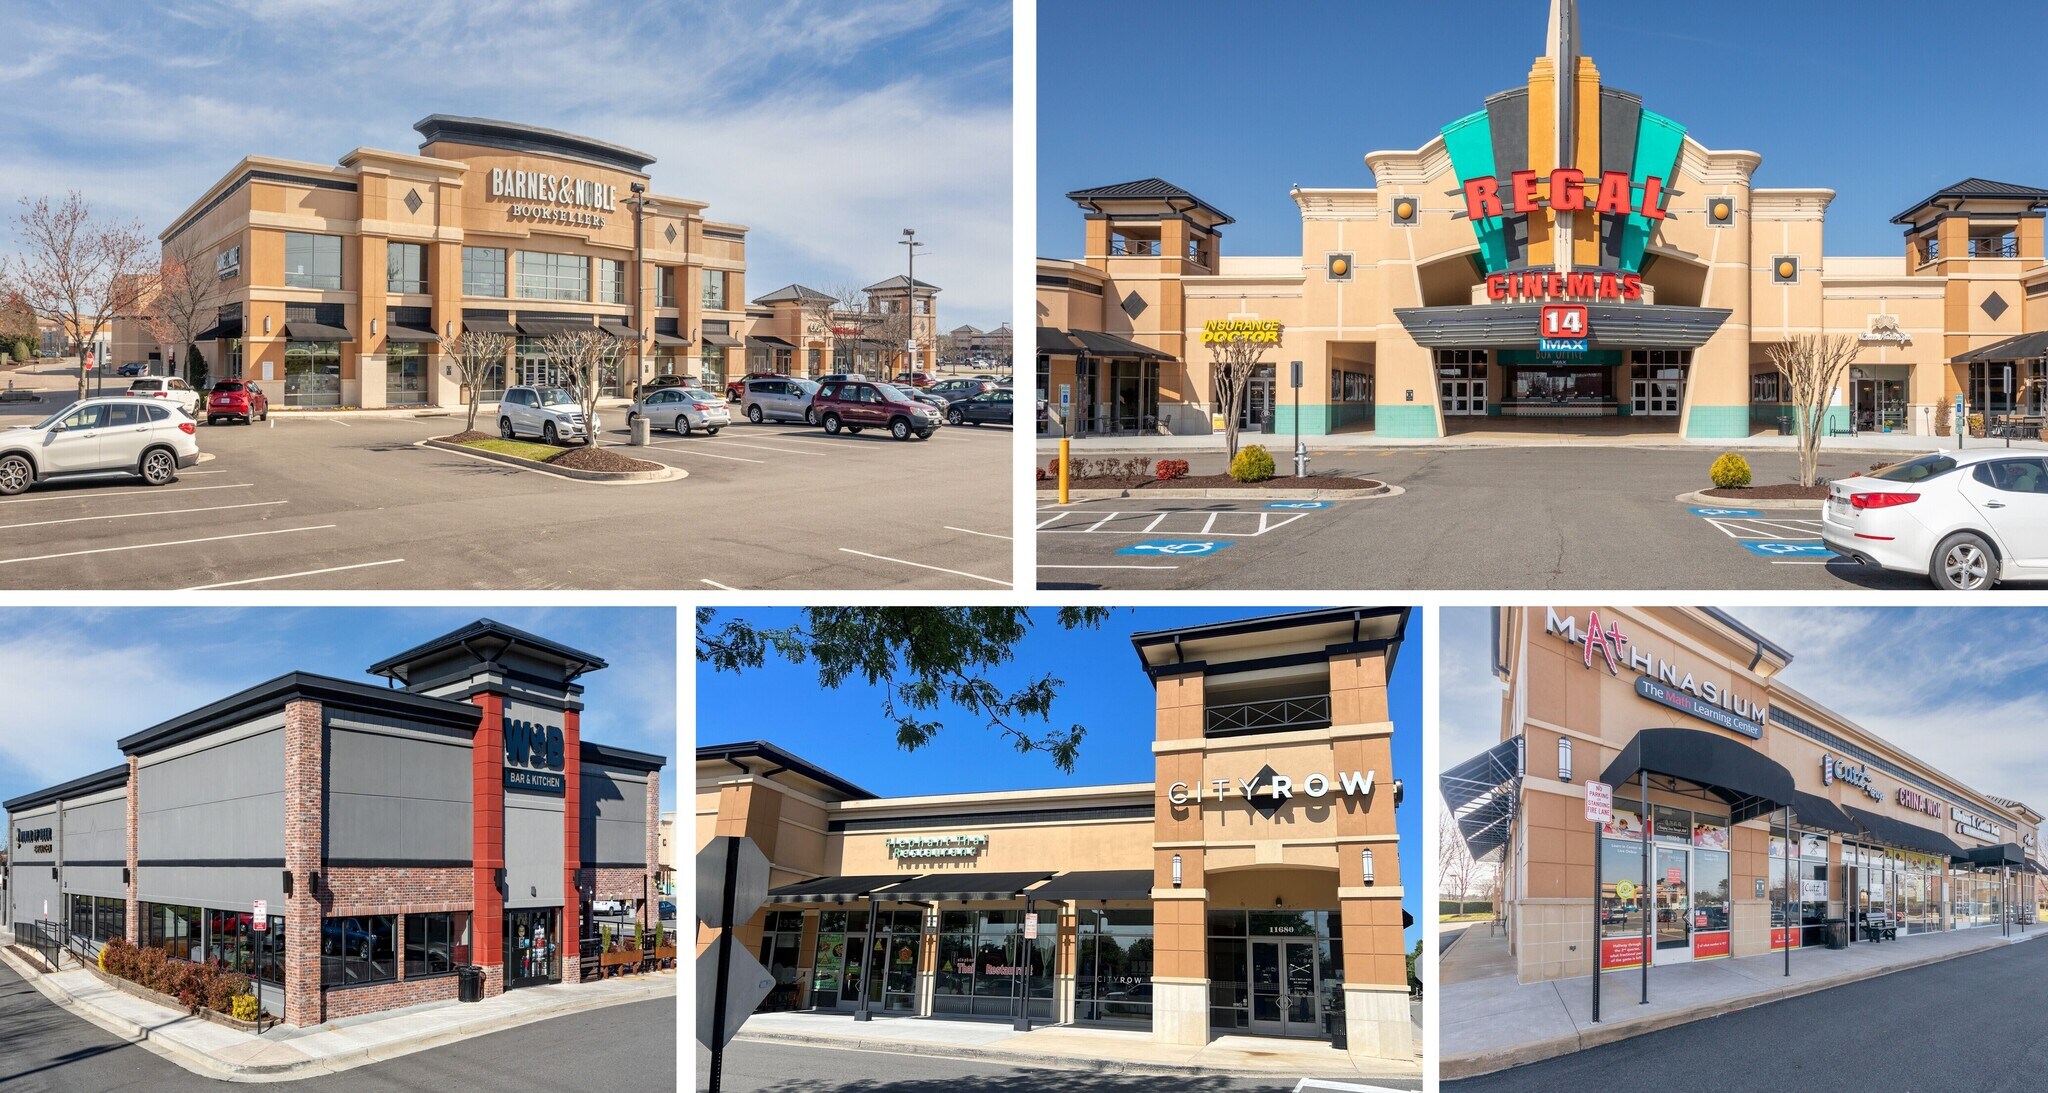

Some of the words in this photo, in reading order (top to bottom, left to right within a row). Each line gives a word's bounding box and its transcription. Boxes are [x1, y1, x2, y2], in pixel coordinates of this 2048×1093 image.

[1464, 168, 1667, 222] REGAL
[513, 203, 606, 227] BOOKSELLERS
[1486, 272, 1642, 300] CINEMAS
[1204, 319, 1280, 331] INSURANCE
[1546, 310, 1583, 333] 14
[1200, 331, 1279, 343] DOCTOR
[1542, 339, 1584, 350] IMAX
[1642, 680, 1664, 699] The
[1665, 690, 1691, 709] Math
[1693, 701, 1732, 727] Learning
[1733, 717, 1759, 735] Center
[510, 772, 525, 784] BAR
[526, 774, 531, 784] &
[532, 775, 560, 788] KITCHEN
[1589, 791, 1609, 799] PARKING
[1899, 787, 1924, 813] CHINA
[1587, 806, 1597, 814] FIRE
[1598, 808, 1610, 816] LANE
[1588, 800, 1610, 808] STANDING
[885, 836, 952, 850] Elephant
[957, 834, 988, 845] Thai
[893, 846, 977, 858] Restaurant
